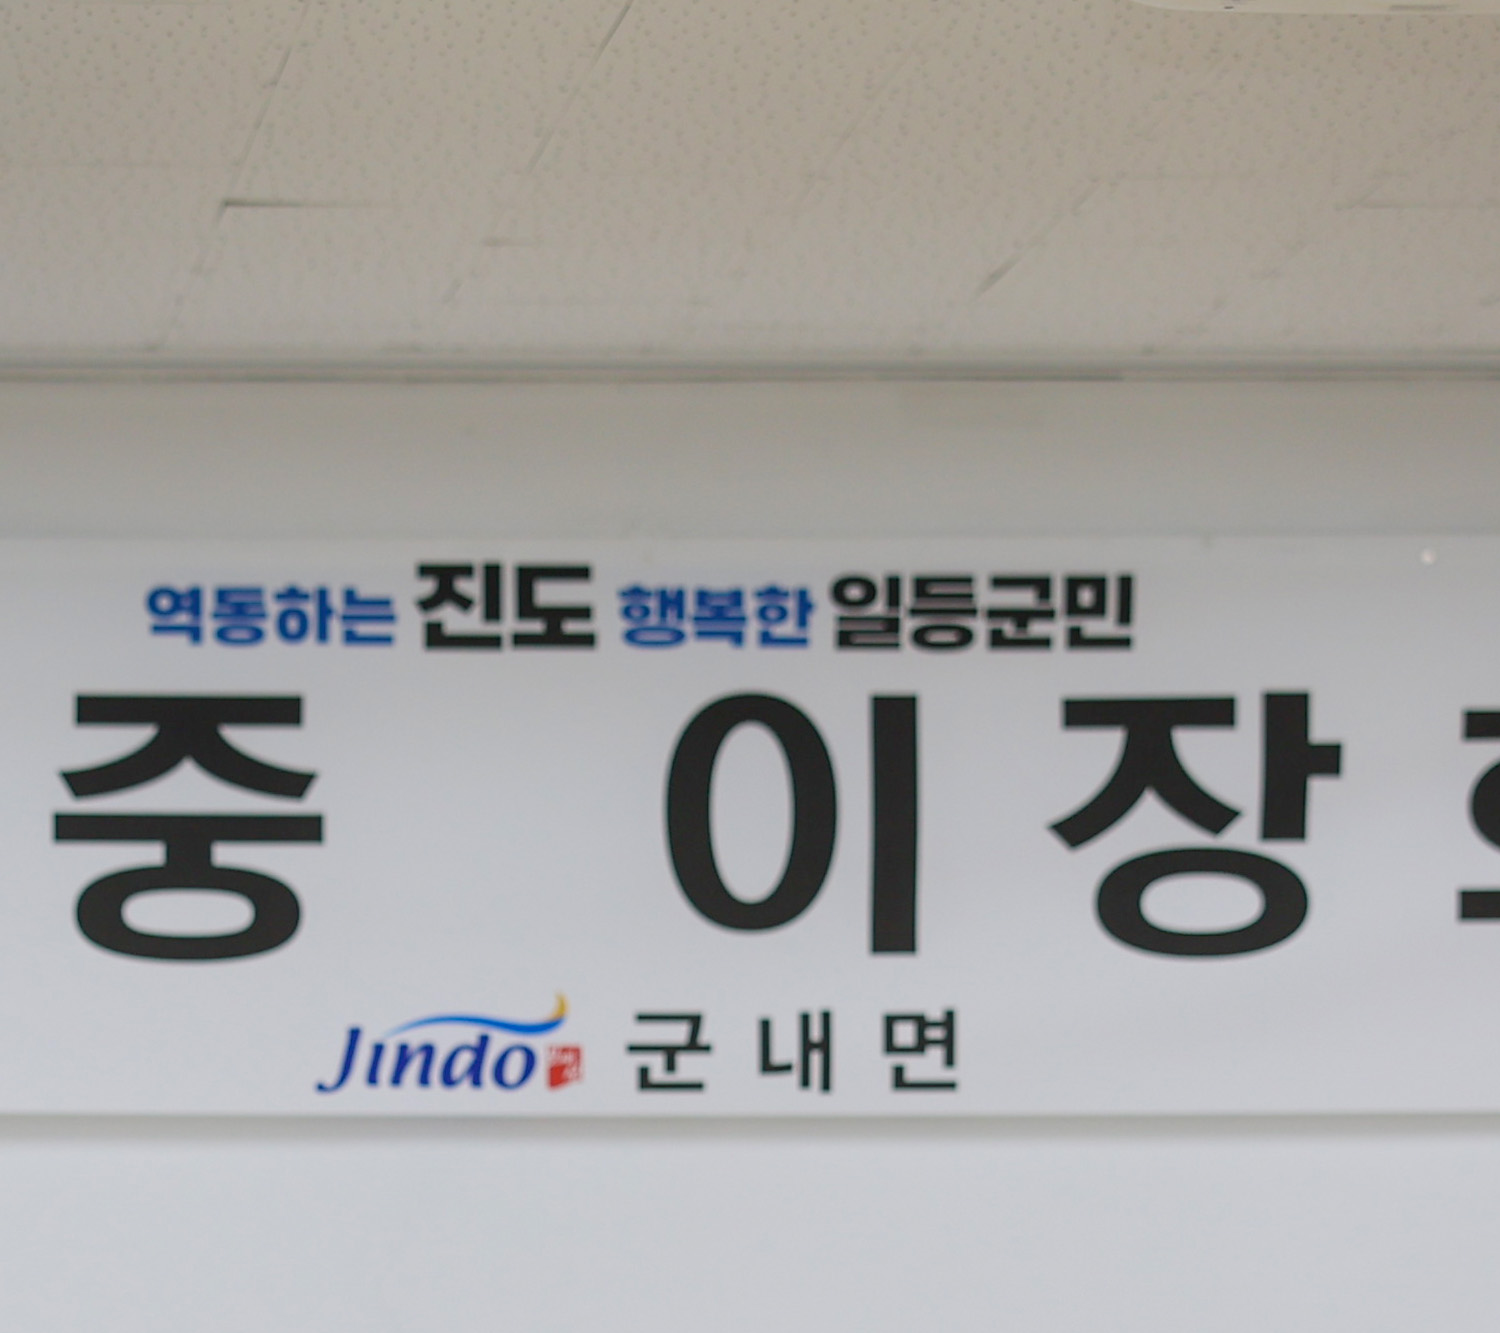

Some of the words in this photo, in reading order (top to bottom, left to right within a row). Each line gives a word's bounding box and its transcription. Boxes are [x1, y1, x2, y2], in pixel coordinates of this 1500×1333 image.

[146, 584, 397, 647] 역동하는
[416, 562, 597, 650] 진도
[617, 584, 816, 649] 행복한
[829, 573, 1135, 651] 일등군민
[316, 1025, 537, 1093] Jindo
[626, 1009, 958, 1093] 군내면
